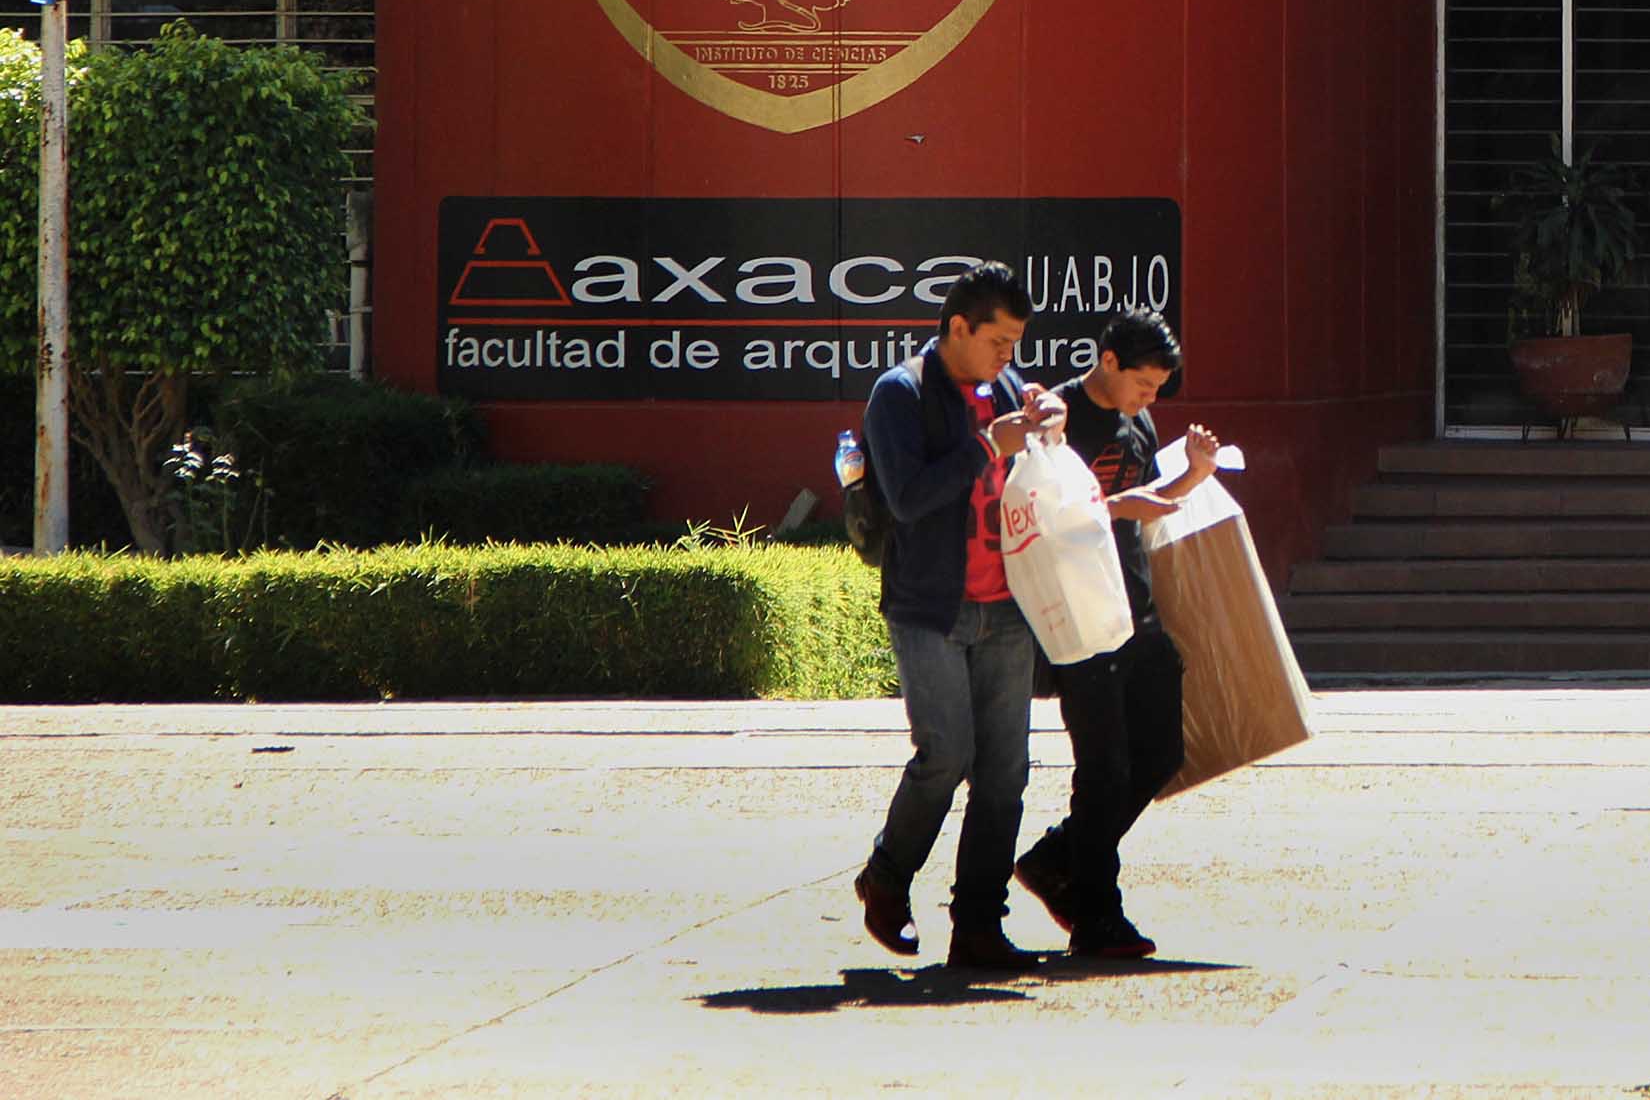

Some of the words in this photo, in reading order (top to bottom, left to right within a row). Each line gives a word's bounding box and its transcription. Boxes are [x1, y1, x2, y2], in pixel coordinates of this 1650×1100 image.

[695, 46, 778, 62] INSTITUTO
[784, 46, 805, 62] DE
[767, 74, 809, 90] 1825
[445, 327, 626, 370] facultad
[649, 328, 720, 370] de
[742, 329, 1099, 379] arquitura
